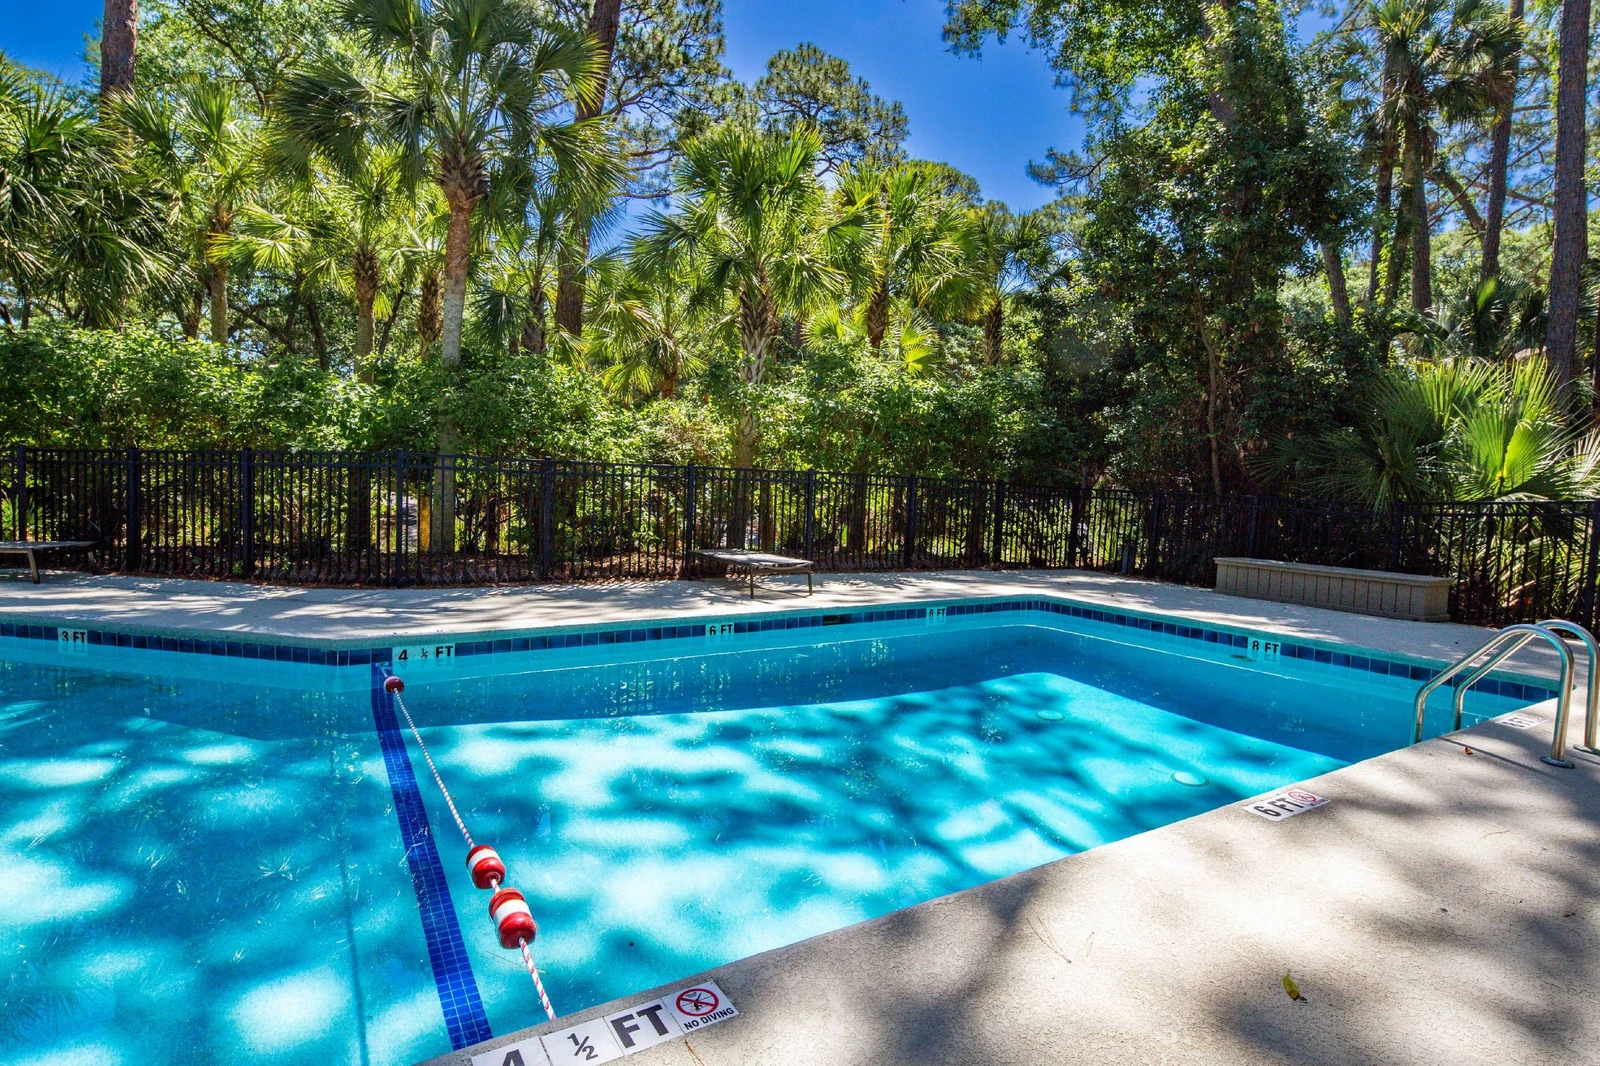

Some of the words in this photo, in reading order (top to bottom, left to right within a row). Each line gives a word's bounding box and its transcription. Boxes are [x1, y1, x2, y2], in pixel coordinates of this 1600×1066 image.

[936, 608, 946, 617] FT
[61, 630, 70, 642] 3
[72, 631, 86, 643] FT
[709, 625, 717, 636] 6
[720, 623, 733, 635] FT
[398, 648, 409, 661] 4
[435, 645, 454, 658] FT
[1251, 639, 1260, 651] 8
[1264, 641, 1280, 654] FT
[1253, 805, 1281, 817] 6
[1267, 797, 1305, 813] FT
[683, 1019, 700, 1030] NO
[700, 1007, 735, 1024] DIVING
[610, 1004, 670, 1049] FT
